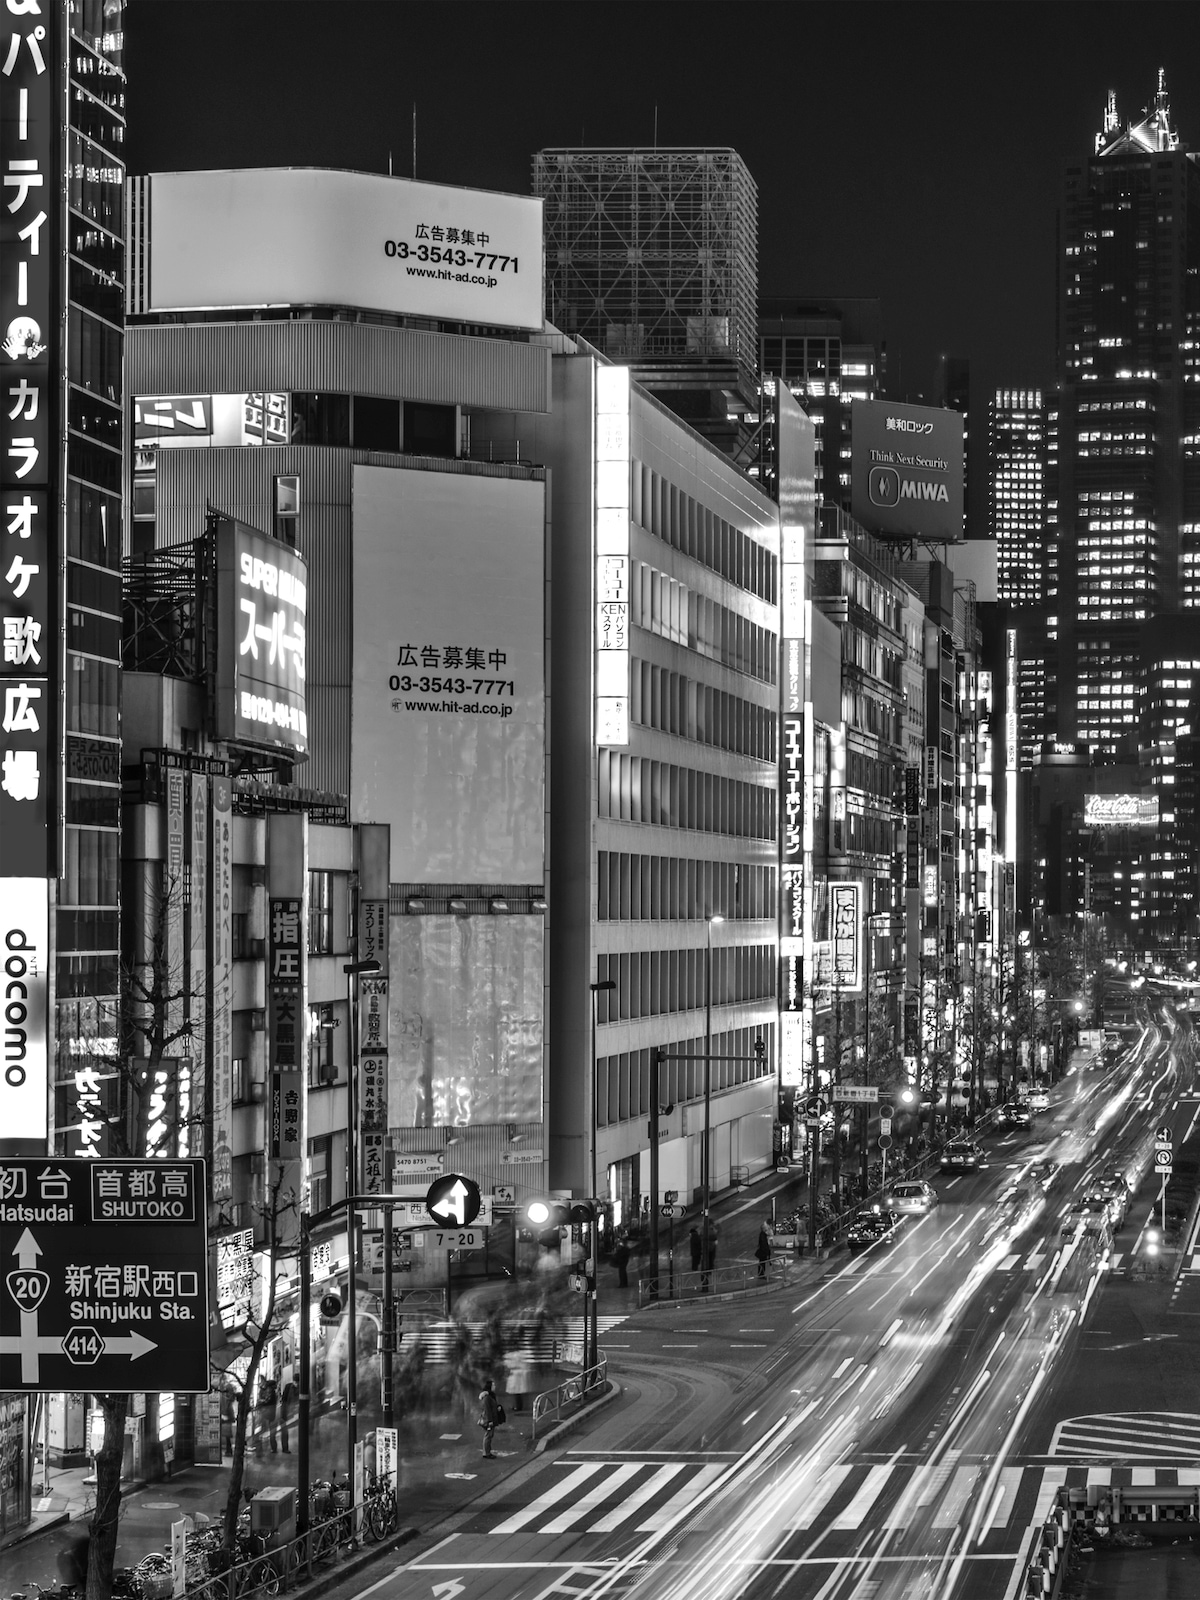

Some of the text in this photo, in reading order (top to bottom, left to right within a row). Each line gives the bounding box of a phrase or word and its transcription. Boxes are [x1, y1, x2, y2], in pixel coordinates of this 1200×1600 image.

[415, 223, 490, 248] 広告募集中
[384, 240, 519, 274] 03-3543-7771
[406, 266, 498, 288] www.hit-ad.co.jp
[886, 417, 934, 434] 美和ロック
[870, 449, 948, 470] Think Next Security
[901, 480, 950, 502] MIWA
[611, 558, 624, 599] コーユー
[600, 604, 626, 615] KEN
[602, 615, 612, 648] スクール
[397, 643, 507, 671] 広告募集中
[389, 675, 515, 696] 03-3543-7771
[405, 701, 513, 717] www.hit-ad.co.jp
[273, 912, 299, 977] 指圧
[5, 929, 36, 1087] docomo
[276, 1002, 296, 1065] 大黒屋
[285, 1089, 299, 1143] 吉野家
[0, 1166, 71, 1200] 初台
[97, 1170, 188, 1198] 首都高
[102, 1201, 184, 1217] SHUTOKO
[15, 1277, 41, 1299] 20
[65, 1264, 199, 1298] 新宿駅西口
[70, 1302, 195, 1323] Shinjuku Sta.
[69, 1336, 98, 1355] 414
